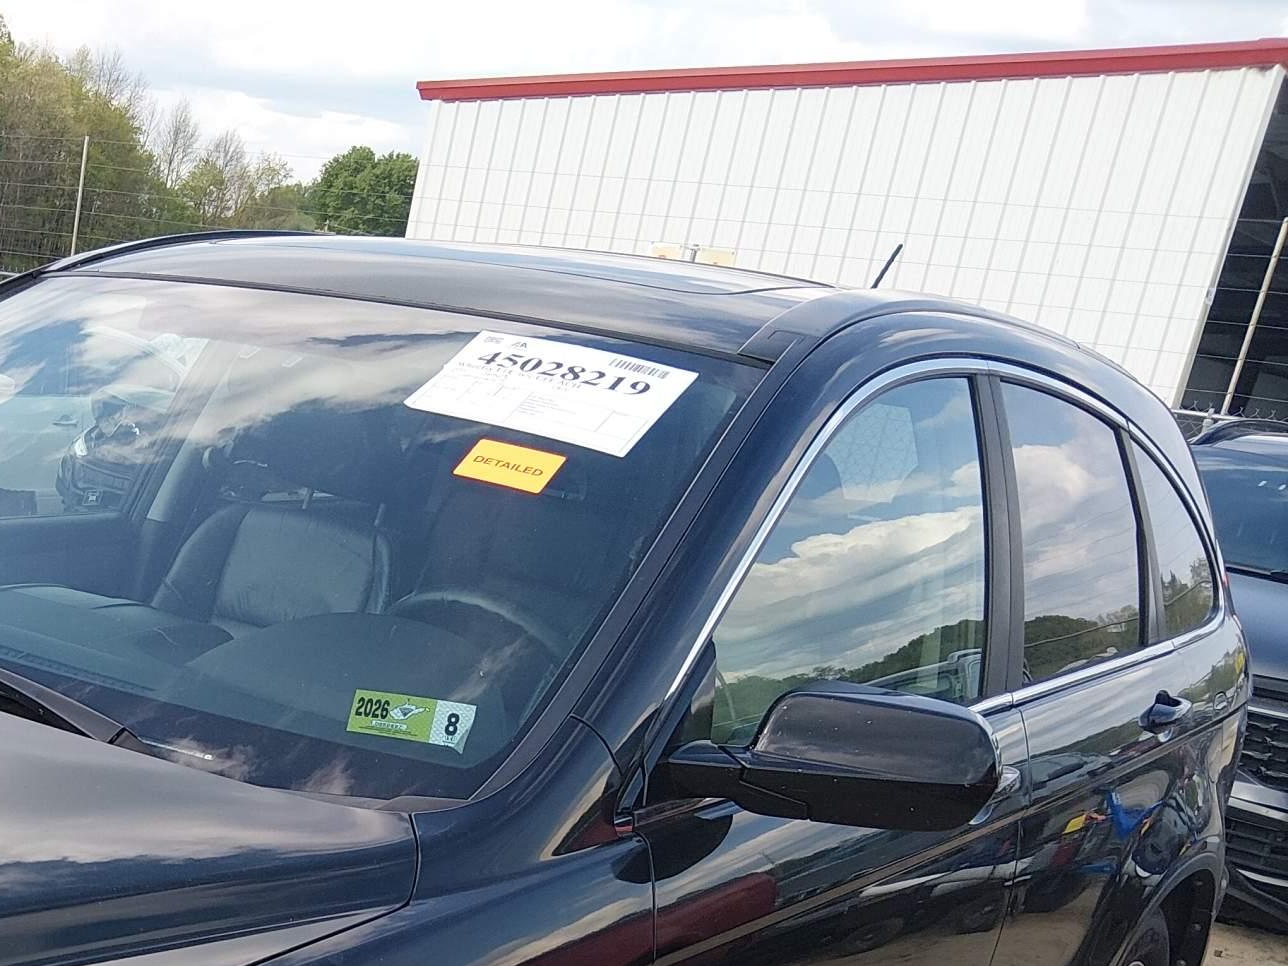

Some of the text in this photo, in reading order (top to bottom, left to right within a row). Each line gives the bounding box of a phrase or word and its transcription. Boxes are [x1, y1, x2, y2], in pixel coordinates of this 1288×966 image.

[478, 351, 651, 396] 45028219
[473, 455, 544, 477] DETAILED
[355, 697, 391, 720] 2026
[444, 712, 460, 736] 8
